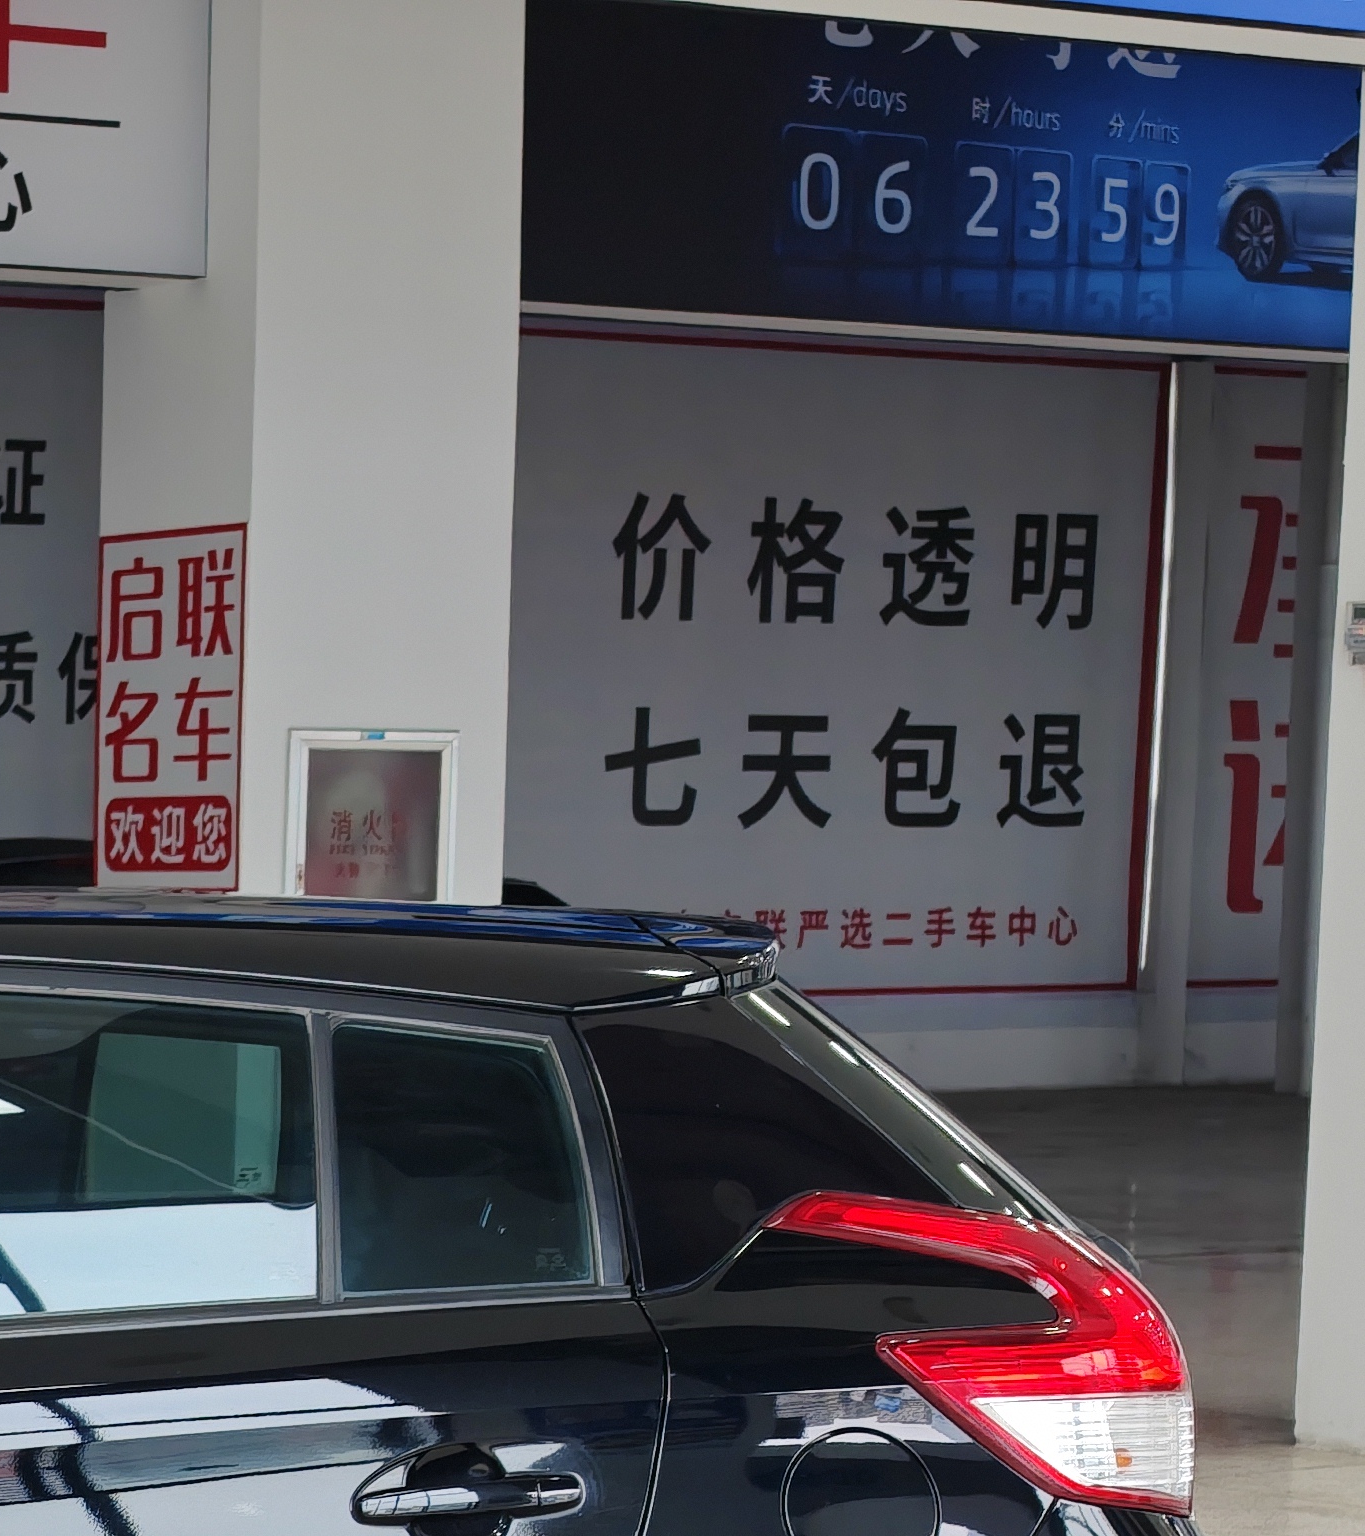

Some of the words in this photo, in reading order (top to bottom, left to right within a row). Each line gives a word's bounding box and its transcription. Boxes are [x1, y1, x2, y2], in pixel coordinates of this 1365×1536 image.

[105, 547, 236, 663] 启联
[612, 491, 1101, 630] 价格透明
[105, 676, 234, 783] 名车
[603, 706, 1085, 829] 七天包退
[109, 803, 227, 866] 欢迎您
